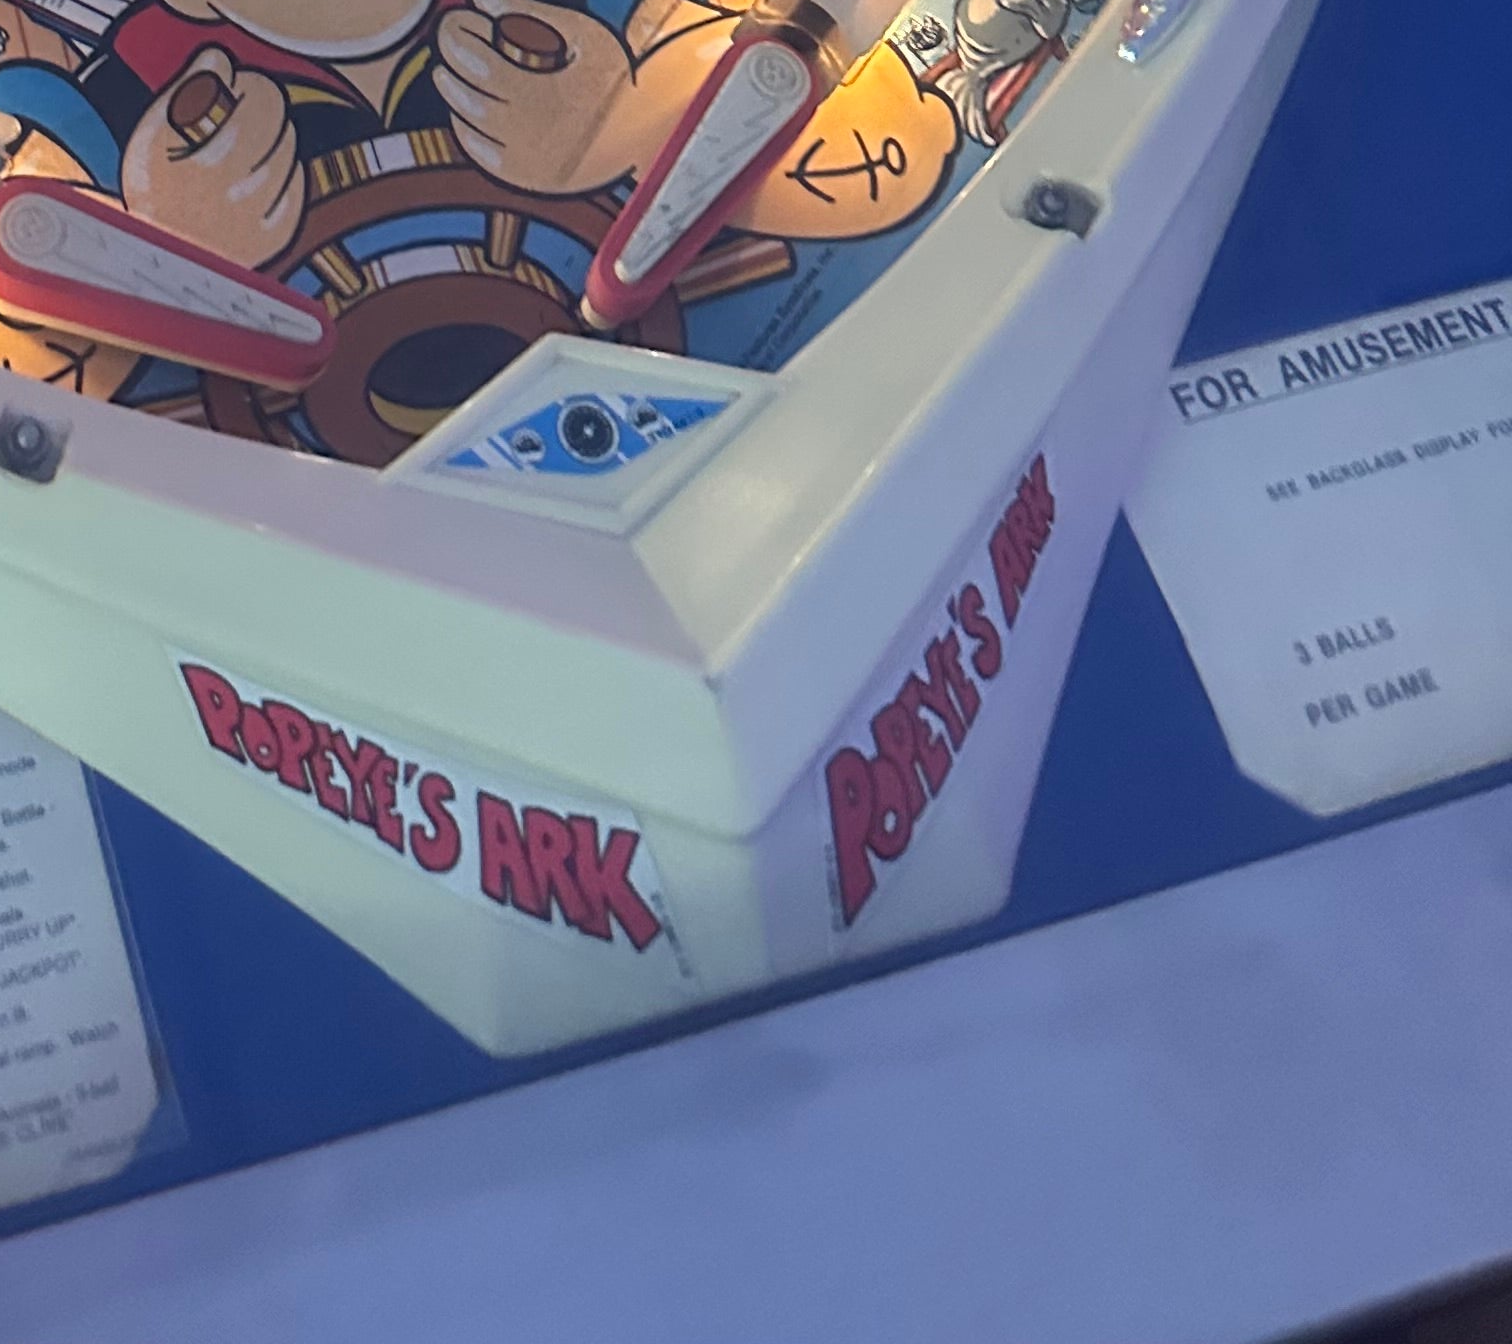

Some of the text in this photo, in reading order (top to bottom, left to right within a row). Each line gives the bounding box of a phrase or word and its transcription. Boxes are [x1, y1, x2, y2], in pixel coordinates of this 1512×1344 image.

[1169, 296, 1512, 419] FOR AMUSEMENT
[1412, 426, 1480, 462] DISPLAY
[1315, 616, 1396, 659] BALLS
[825, 451, 1056, 928] POPEYE'S ARK
[1304, 666, 1441, 729] PER GAME
[179, 662, 463, 873] POPEYE'S
[475, 786, 662, 954] ARK
